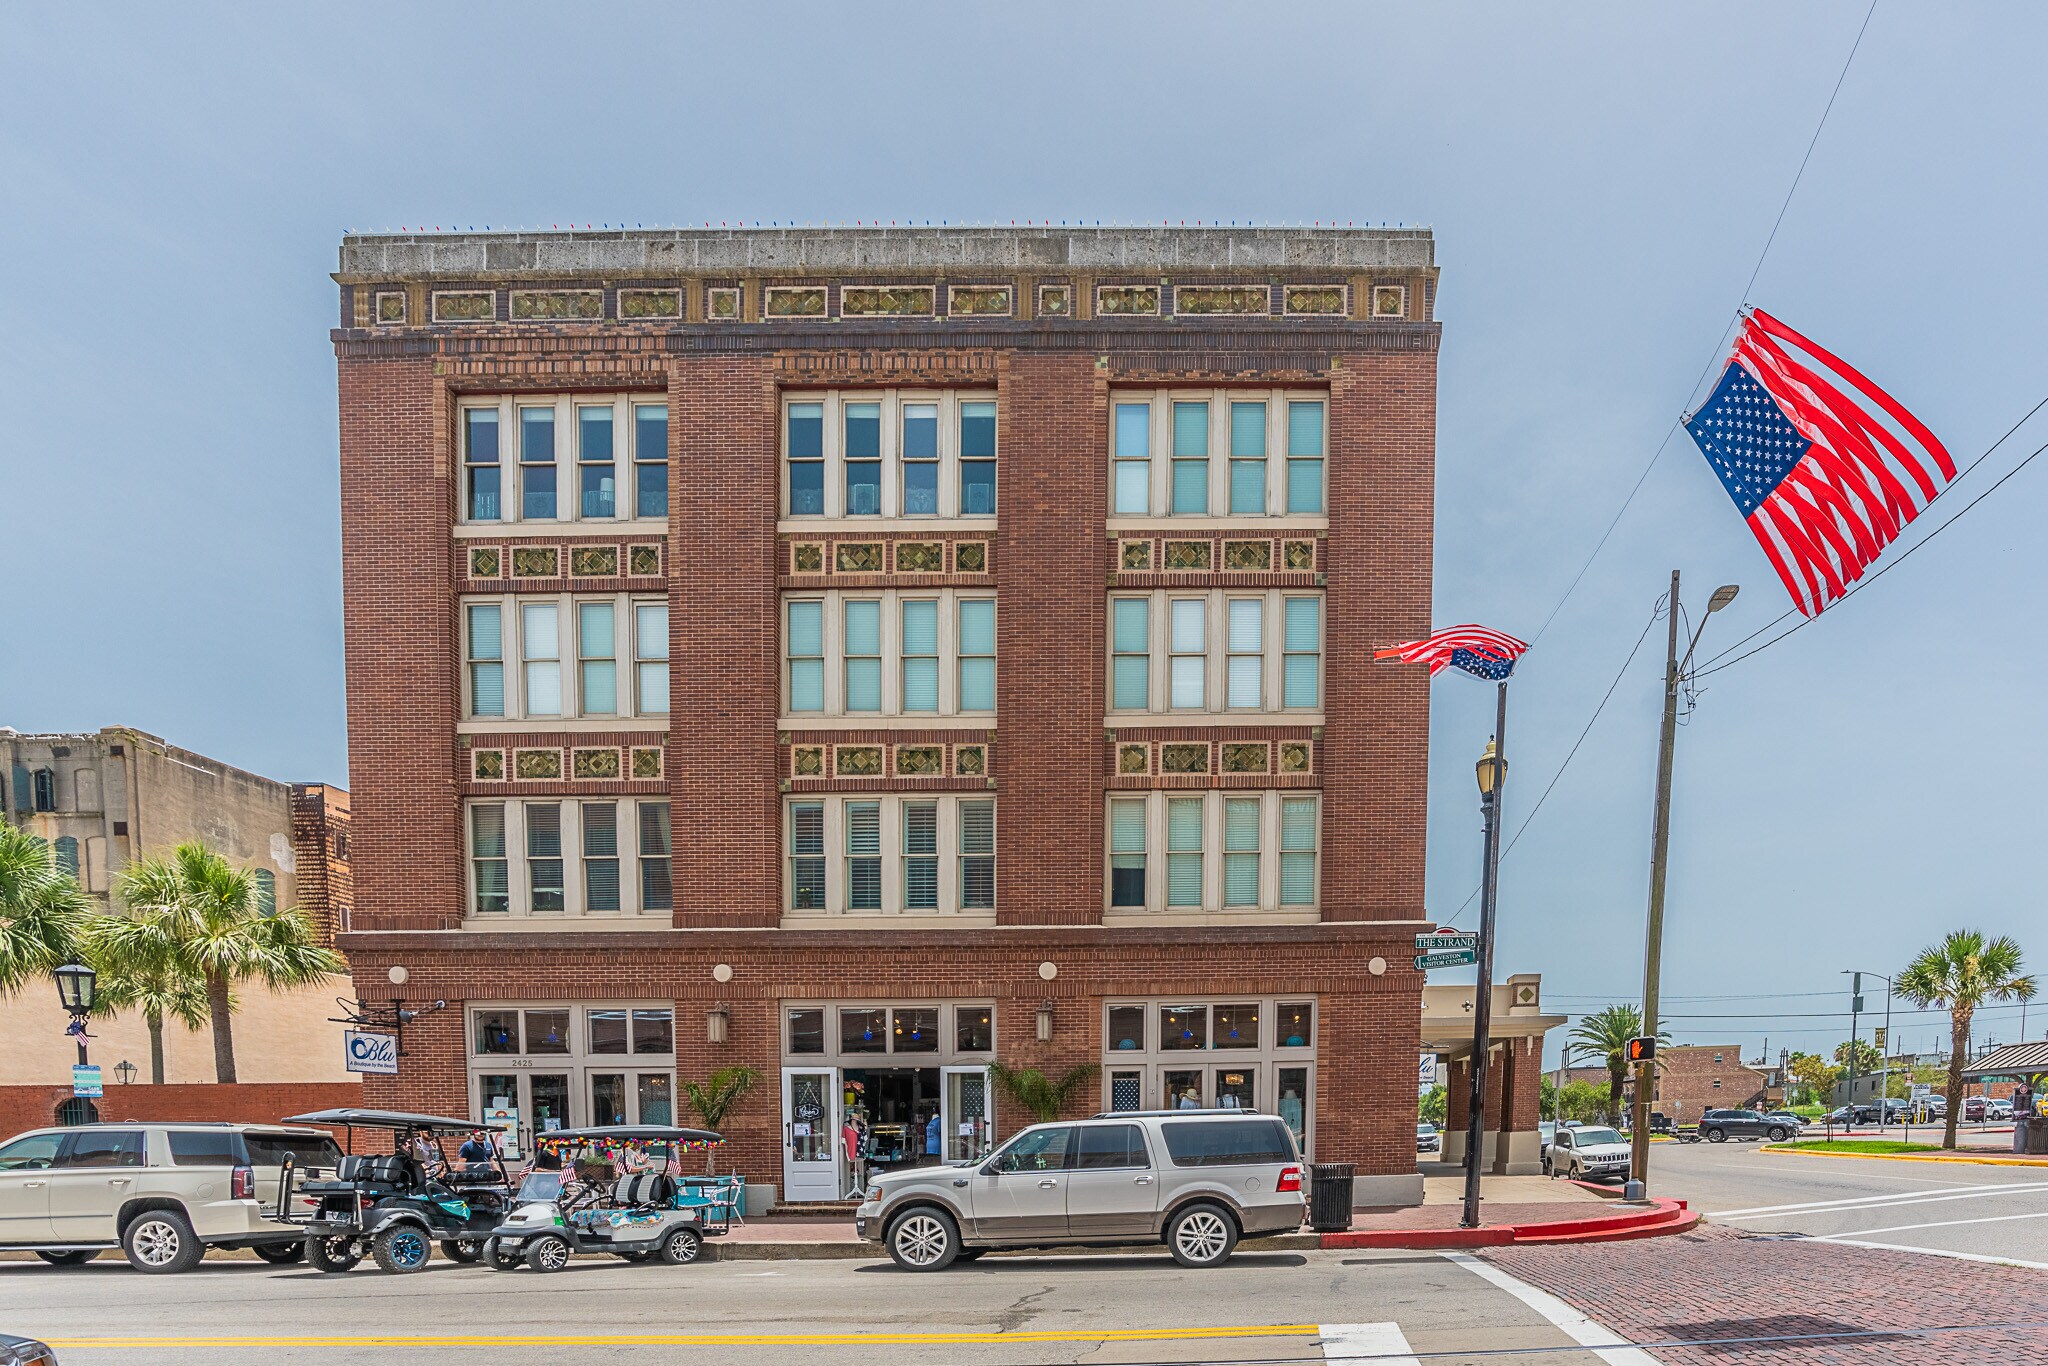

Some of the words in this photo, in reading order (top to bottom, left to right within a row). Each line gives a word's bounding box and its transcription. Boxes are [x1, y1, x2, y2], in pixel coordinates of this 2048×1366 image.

[1418, 938, 1436, 946] THE
[1438, 938, 1474, 946] STRAND
[1426, 954, 1460, 962] GALVESTON
